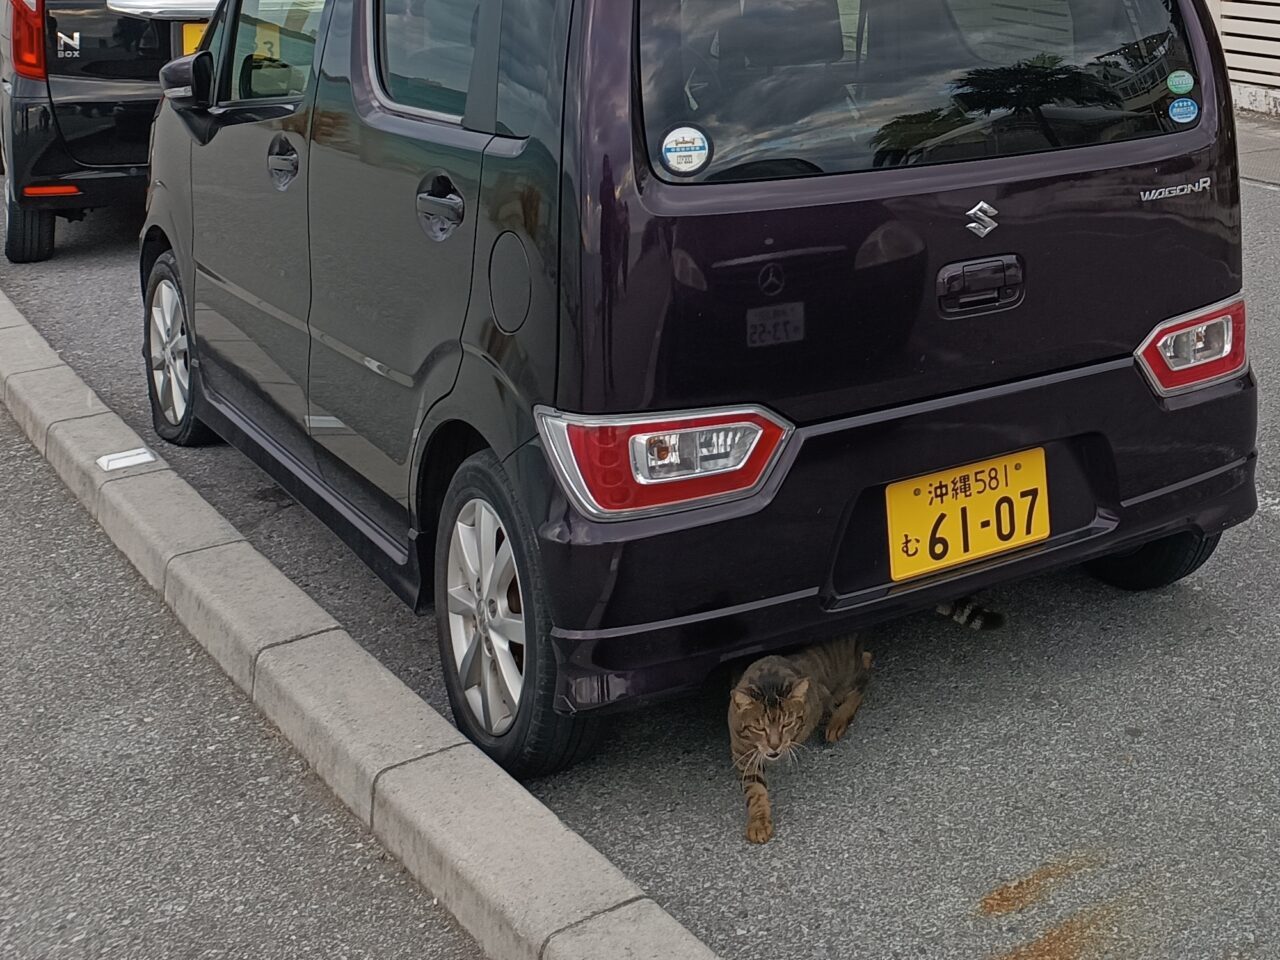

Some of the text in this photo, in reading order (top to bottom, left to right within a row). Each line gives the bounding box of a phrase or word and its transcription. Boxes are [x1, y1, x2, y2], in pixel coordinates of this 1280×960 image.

[57, 31, 80, 50] N
[57, 50, 80, 58] BOX
[901, 487, 1039, 561] む 61-07
